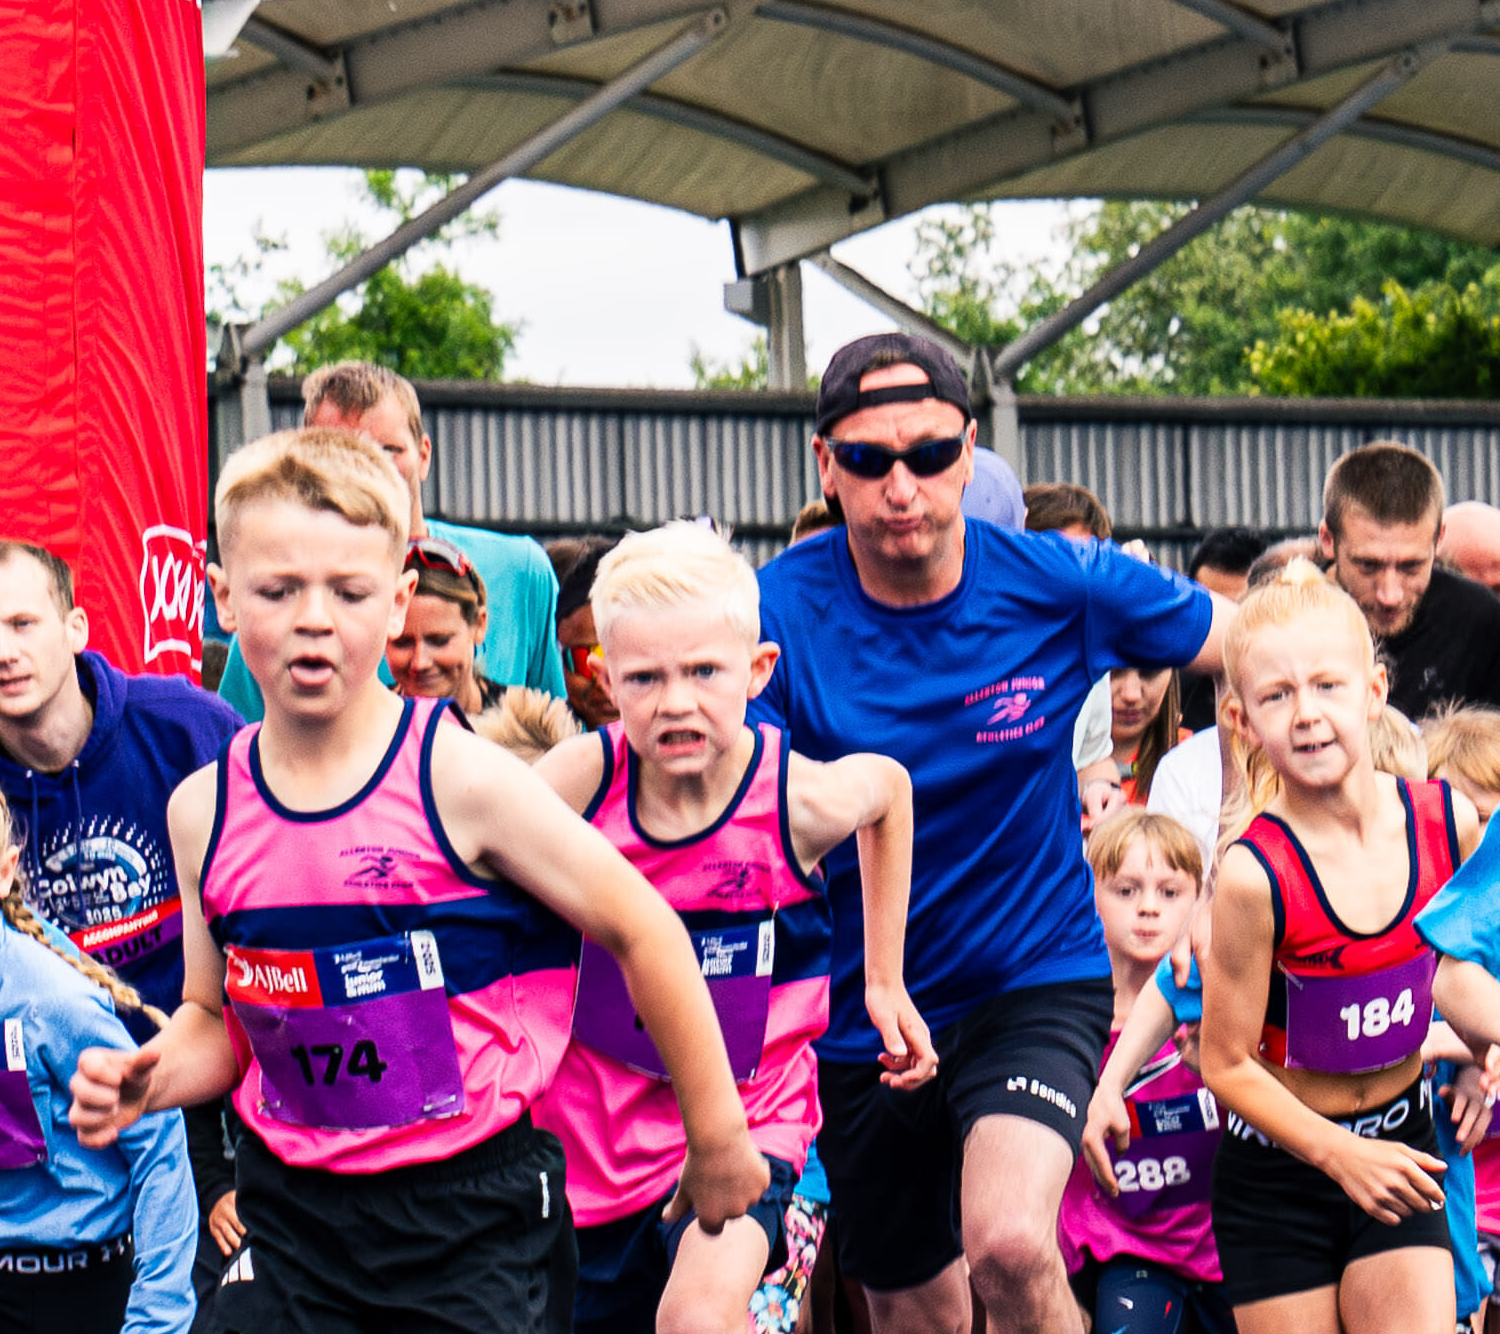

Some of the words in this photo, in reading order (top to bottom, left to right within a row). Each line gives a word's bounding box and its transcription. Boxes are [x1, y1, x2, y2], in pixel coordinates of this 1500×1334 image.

[1340, 987, 1416, 1041] 184
[291, 1040, 388, 1087] 174
[1114, 1155, 1191, 1193] 288
